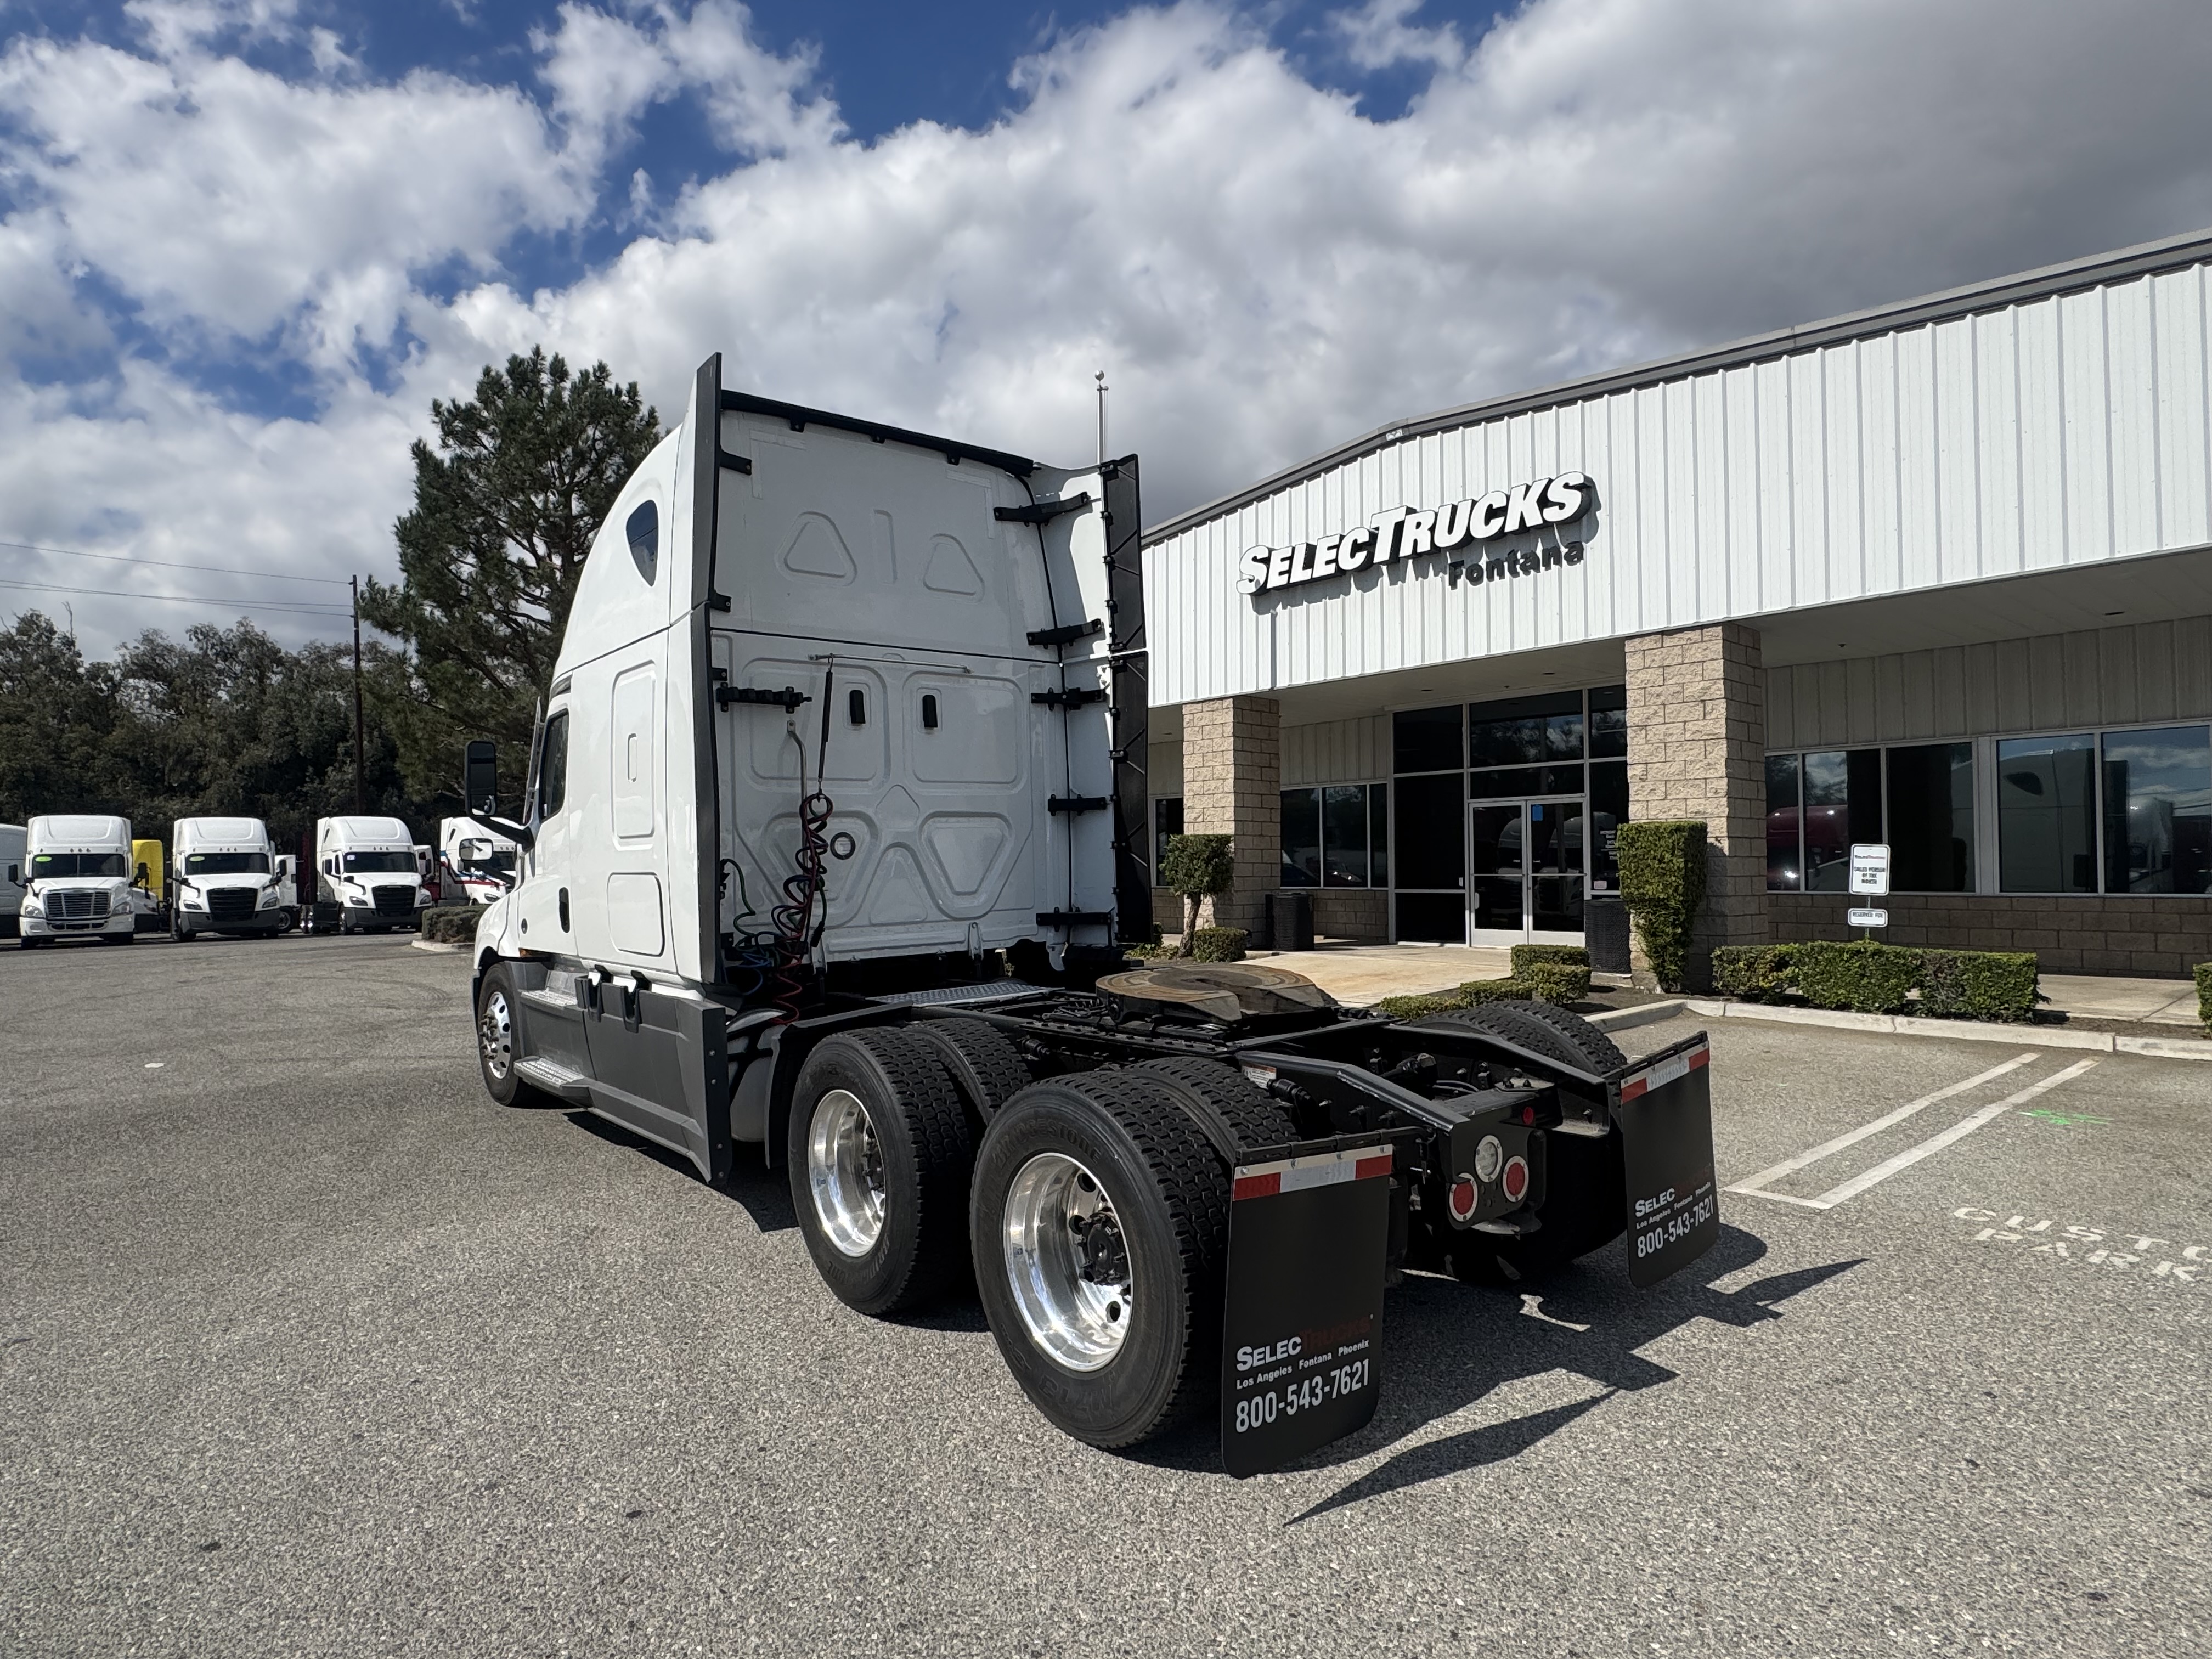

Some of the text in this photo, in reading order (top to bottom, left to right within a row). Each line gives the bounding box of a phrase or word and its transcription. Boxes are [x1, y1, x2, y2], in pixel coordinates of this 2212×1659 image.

[1448, 541, 1584, 590] Fontana
[1637, 1194, 1714, 1257] 800-543-7621
[1237, 1339, 1369, 1390] Los Angeles Fontana Phoenix
[1235, 1358, 1369, 1433] 800-543-7621
